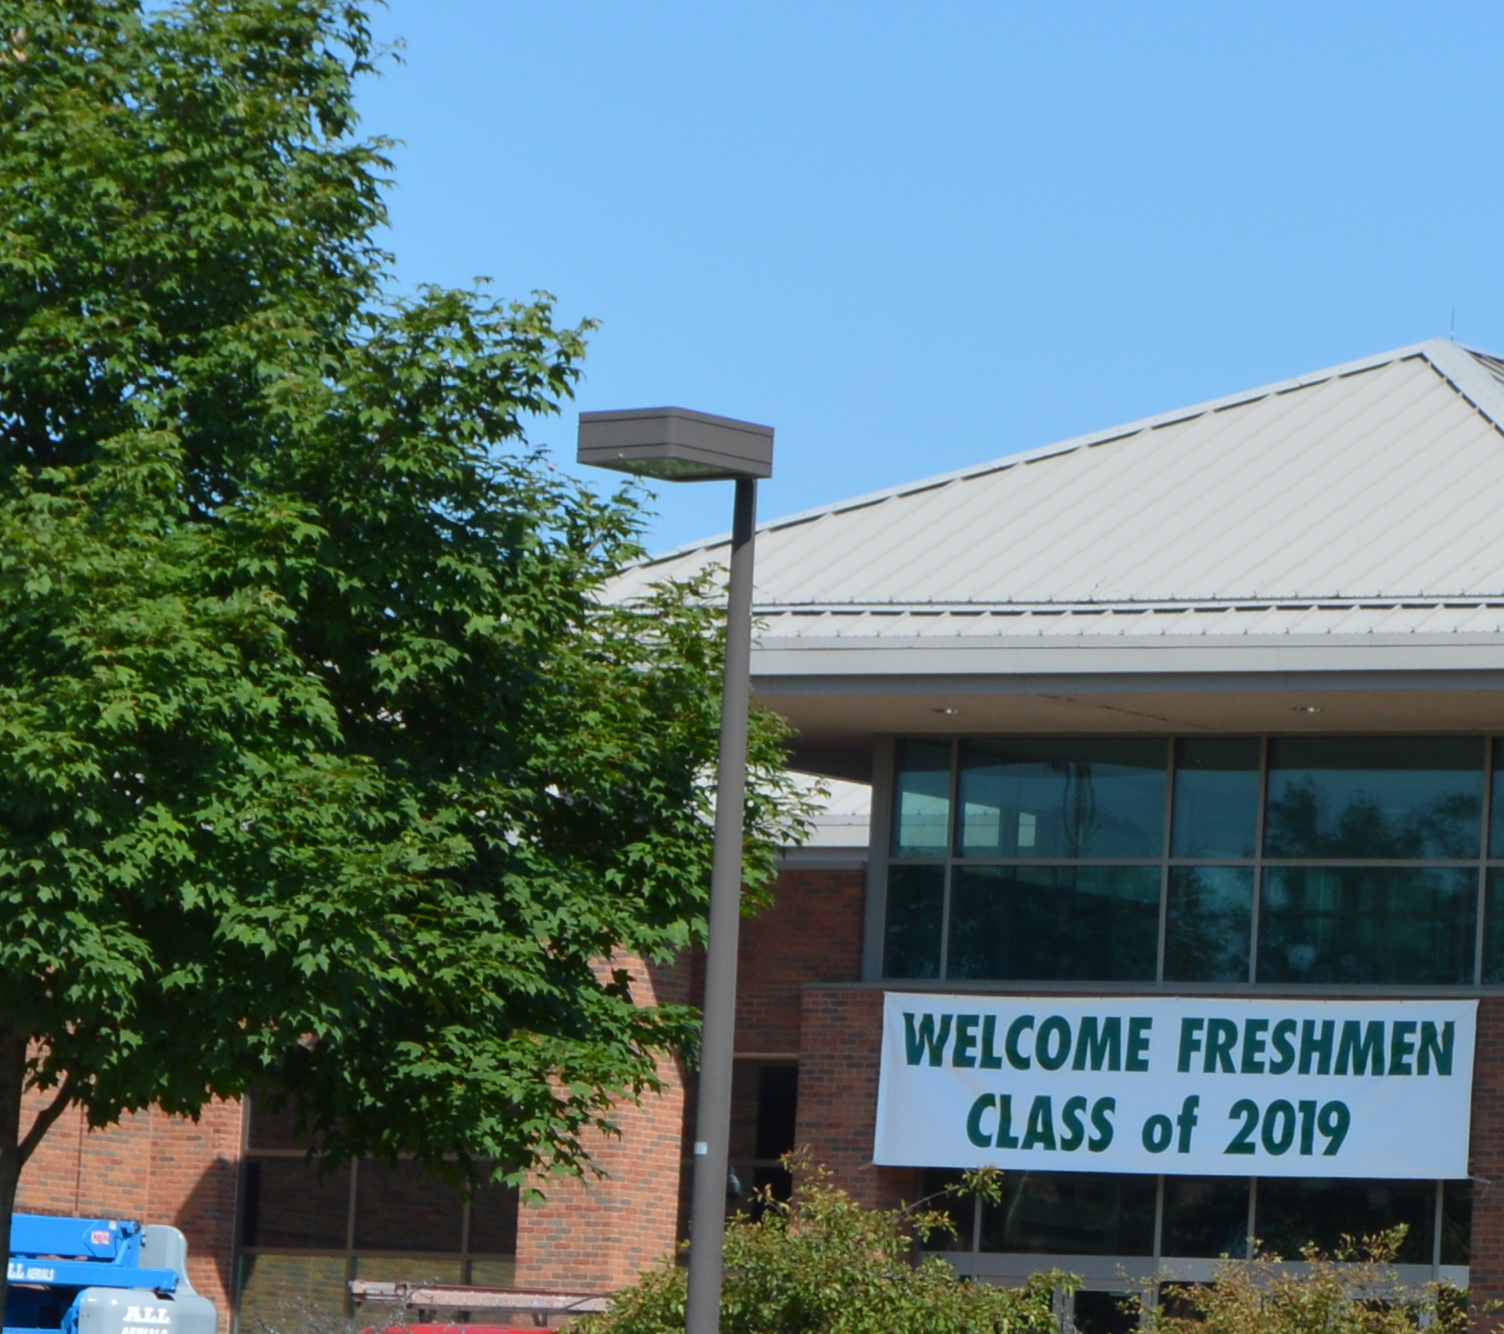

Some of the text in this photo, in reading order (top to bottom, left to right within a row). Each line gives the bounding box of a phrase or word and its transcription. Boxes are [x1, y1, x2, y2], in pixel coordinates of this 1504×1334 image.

[903, 1012, 1455, 1076] WELCOME FRESHMEN
[966, 1093, 1351, 1156] CLASS of 2019
[7, 1262, 24, 1279] LL
[123, 1306, 171, 1324] ALL
